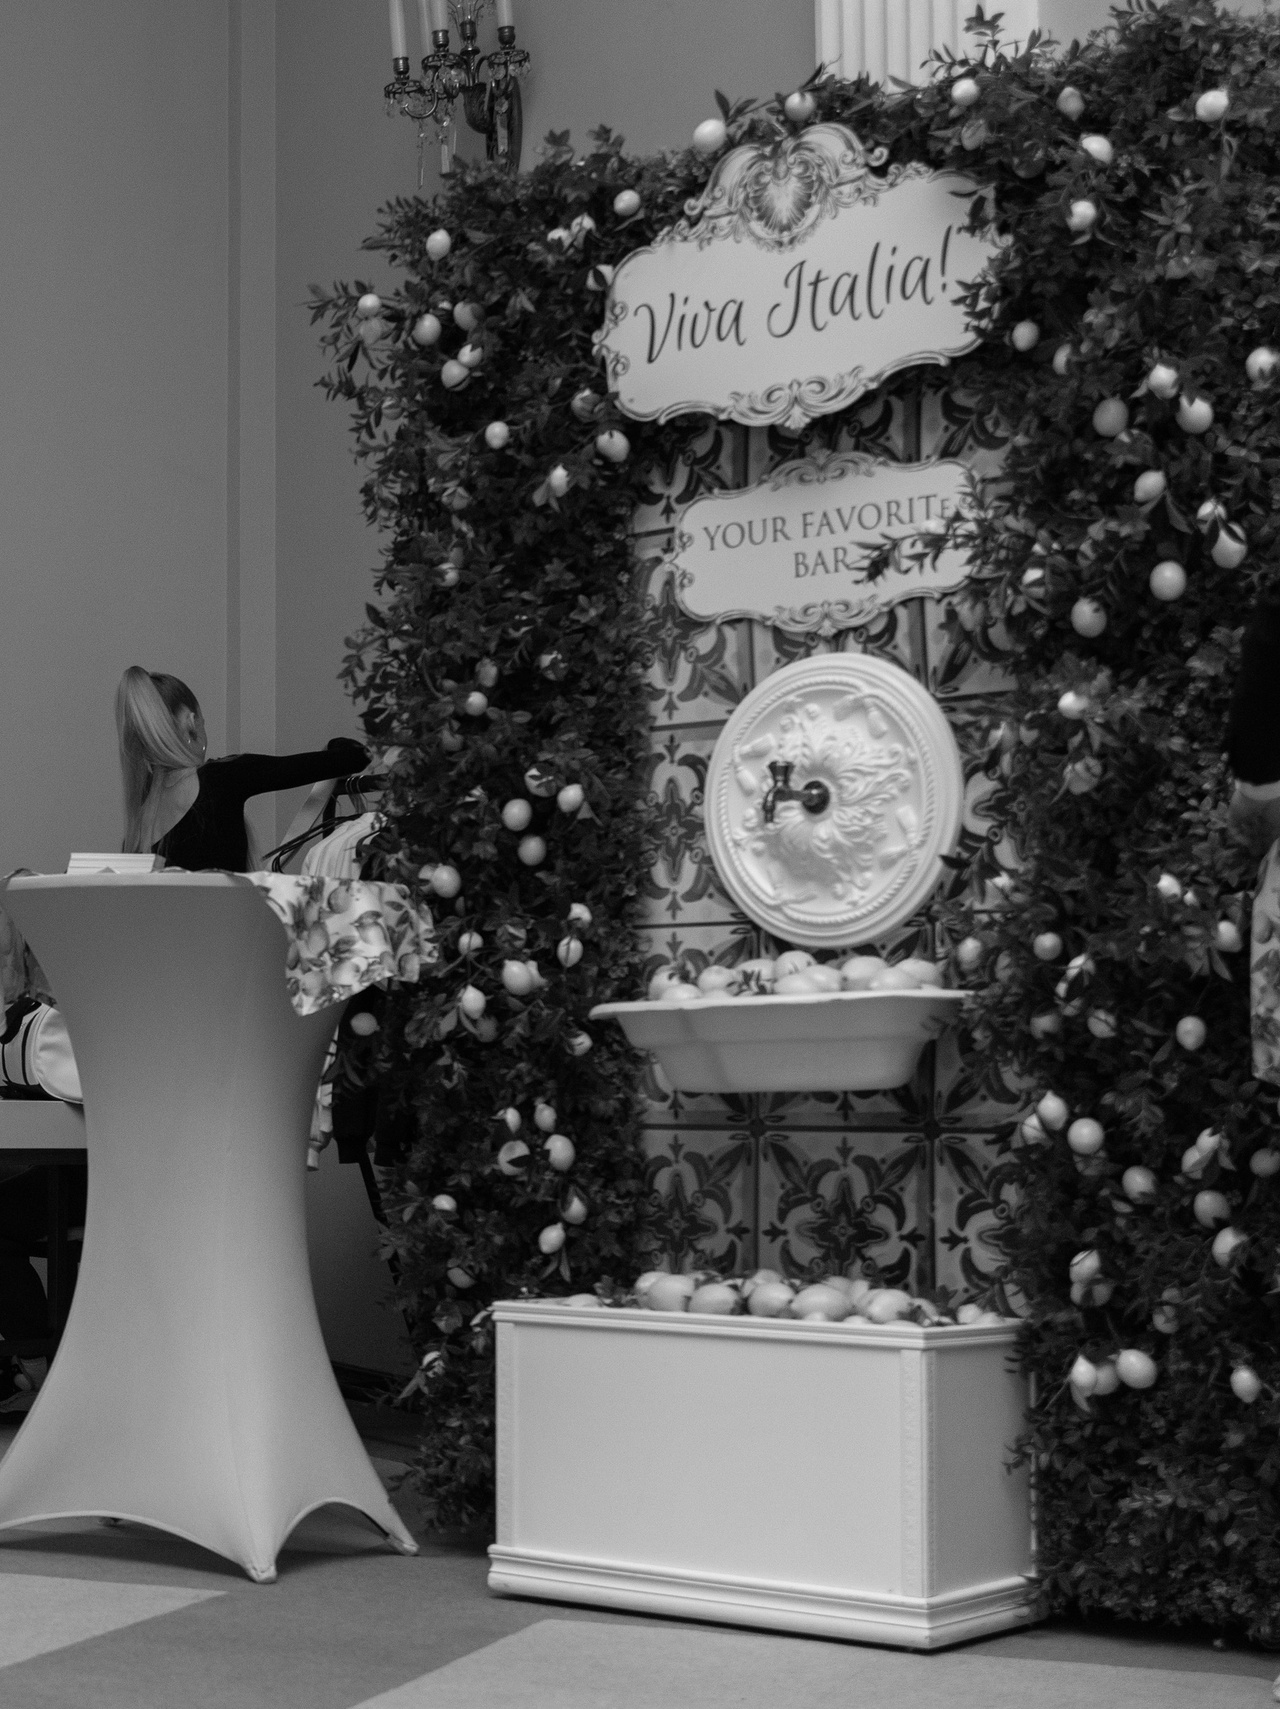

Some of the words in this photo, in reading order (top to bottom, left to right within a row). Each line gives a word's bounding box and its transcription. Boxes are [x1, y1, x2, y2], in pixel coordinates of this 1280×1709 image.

[633, 292, 747, 364] Viva
[767, 225, 952, 338] Italia!
[702, 516, 791, 551] YOUR
[801, 494, 950, 539] FAVORITE
[793, 546, 850, 578] BAR
